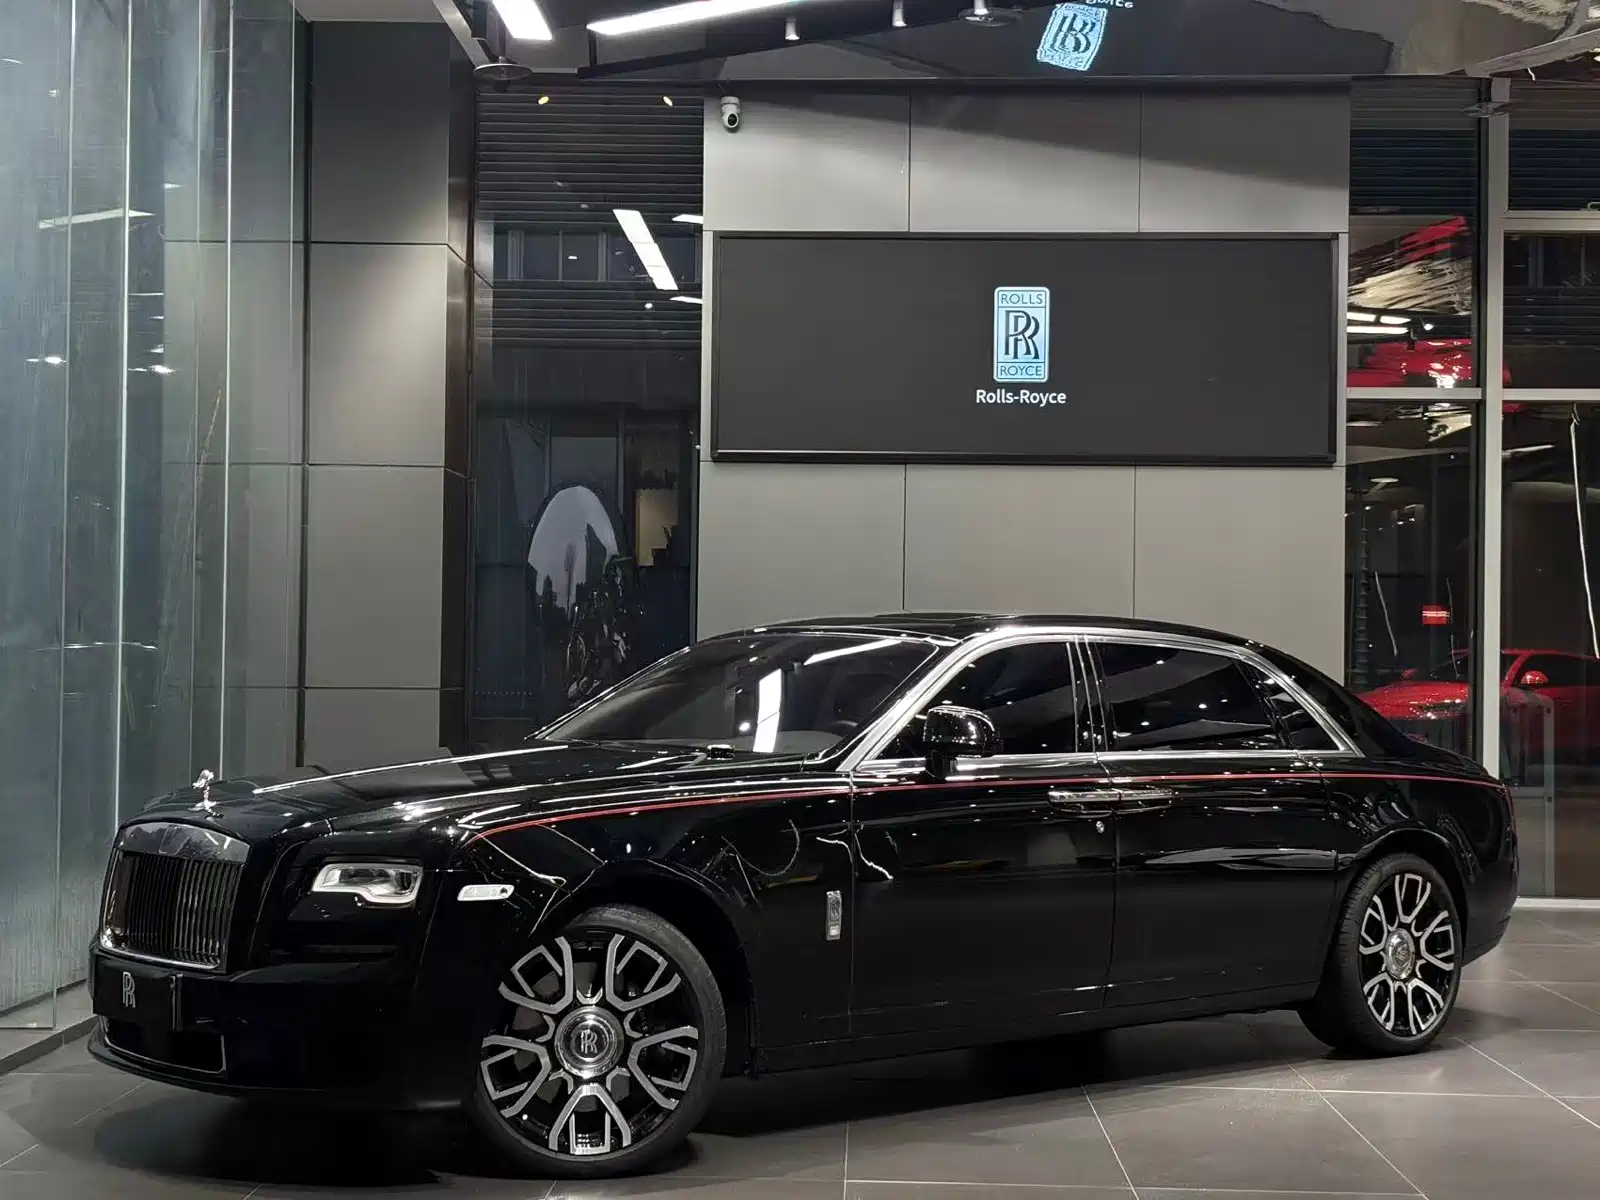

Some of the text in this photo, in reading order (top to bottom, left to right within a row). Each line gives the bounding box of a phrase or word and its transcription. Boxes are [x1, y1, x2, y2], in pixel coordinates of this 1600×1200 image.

[1000, 293, 1043, 305] ROLLS
[1000, 365, 1042, 376] ROYCE
[976, 388, 1067, 407] Rolls-Royce
